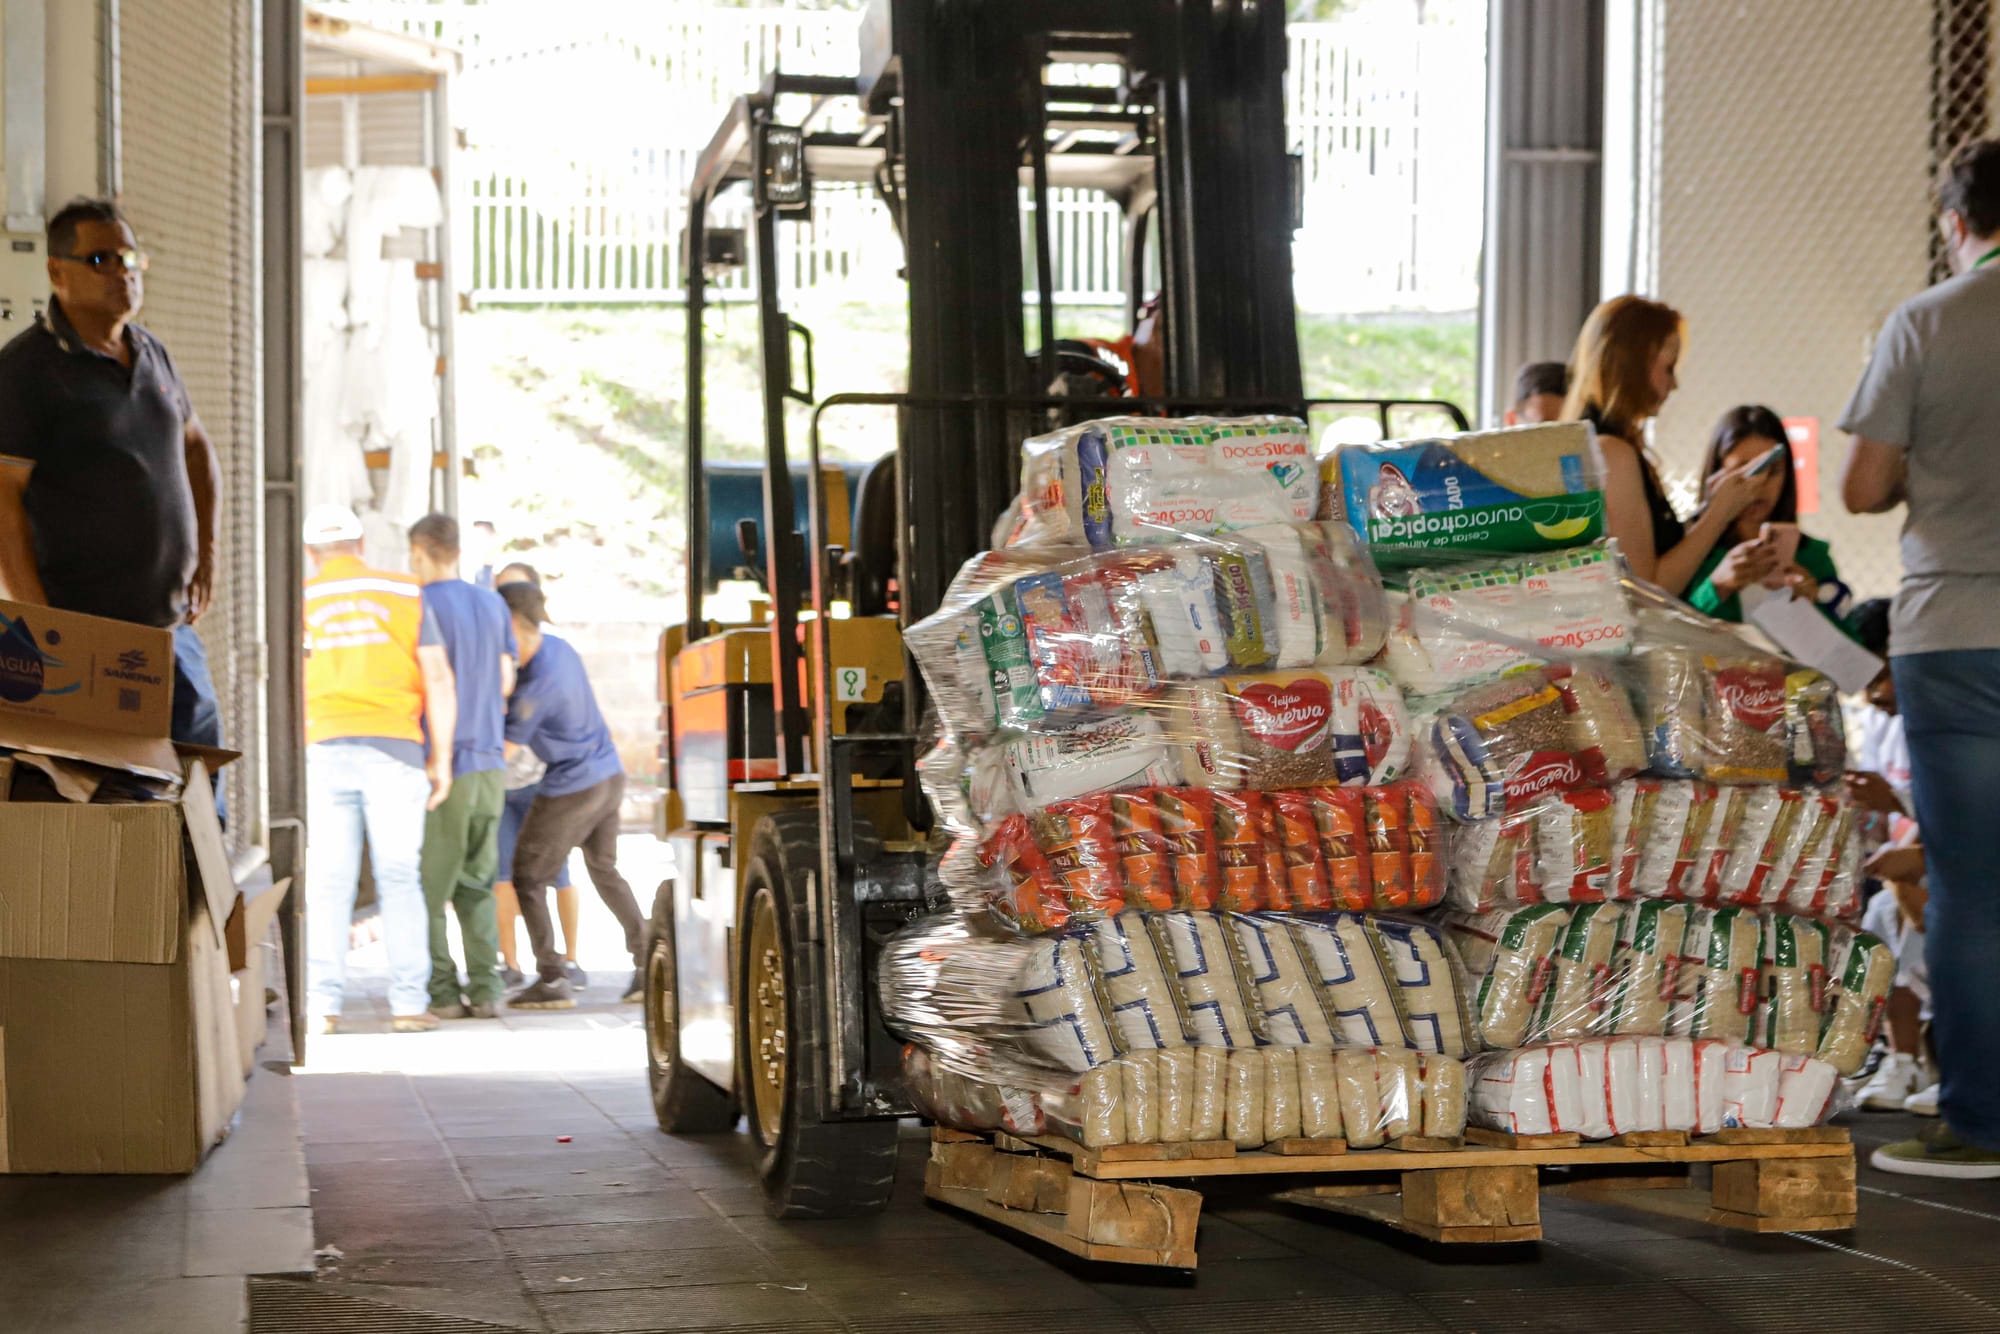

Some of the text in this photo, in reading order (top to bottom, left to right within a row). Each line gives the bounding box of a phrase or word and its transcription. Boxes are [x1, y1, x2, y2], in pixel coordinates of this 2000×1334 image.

[1433, 535, 1450, 547] de
[1451, 530, 1490, 543] Cestas
[1245, 704, 1325, 733] Reserva
